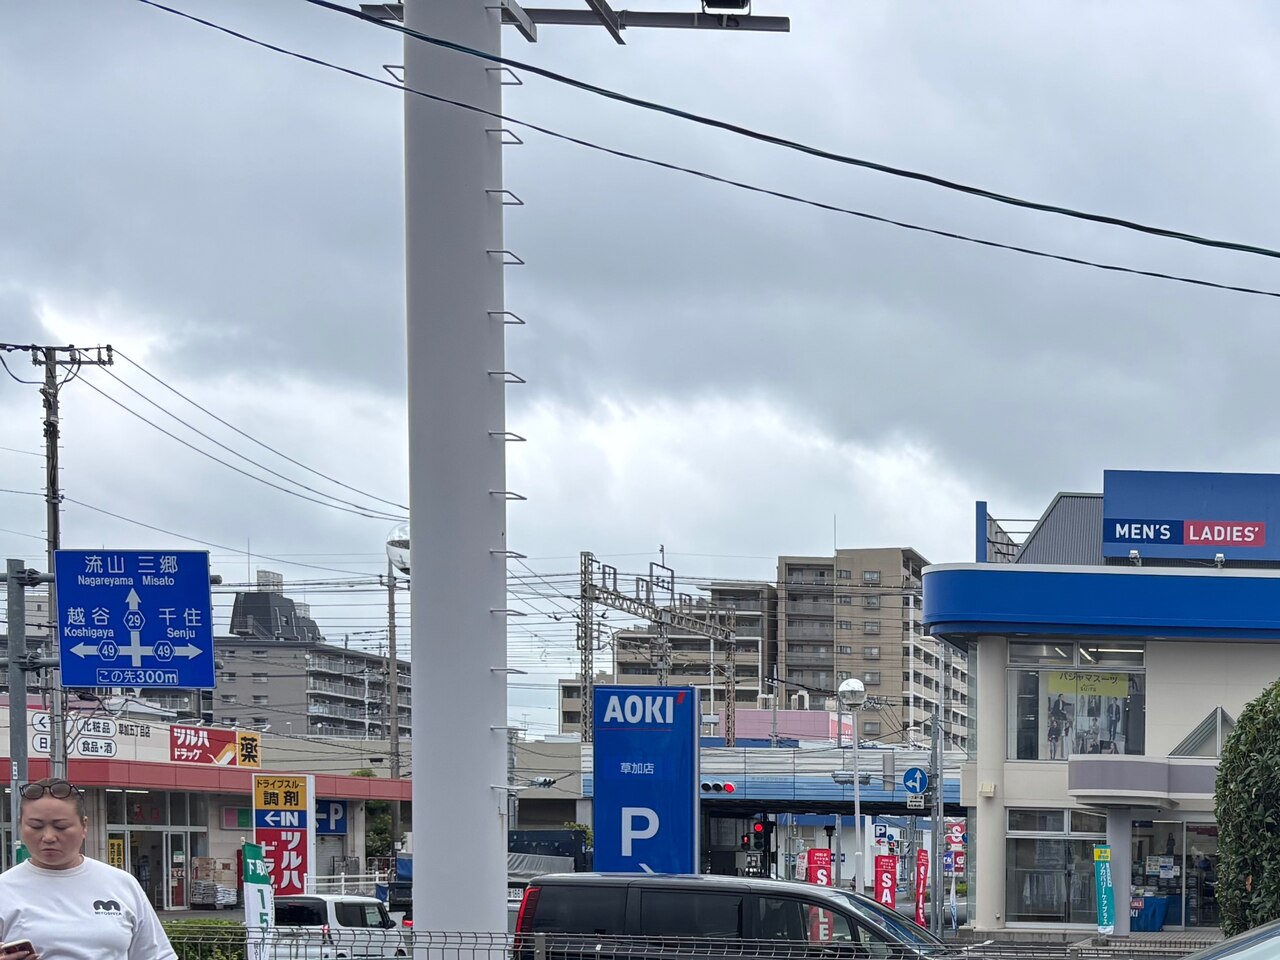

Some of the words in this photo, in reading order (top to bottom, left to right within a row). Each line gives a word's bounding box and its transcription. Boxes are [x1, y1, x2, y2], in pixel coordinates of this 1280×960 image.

[1115, 523, 1171, 540] MEN'S
[1189, 525, 1259, 543] LADIES'
[85, 555, 125, 574] 流山
[138, 555, 179, 574] 三郷
[78, 575, 134, 587] Nagareyama
[142, 575, 175, 586] Misato
[67, 607, 110, 626] 越谷
[128, 615, 141, 627] 29
[158, 607, 202, 627] 千住
[64, 627, 114, 639] Koshigaya
[167, 628, 196, 640] Senju
[101, 645, 115, 657] 49
[157, 645, 170, 657] 49
[99, 670, 178, 683] この先300m
[603, 694, 675, 724] AOKI
[82, 720, 111, 734] 化粧品
[173, 728, 210, 748] ツルハ
[174, 748, 202, 761] ドラッグ
[240, 736, 258, 763] 薬
[620, 762, 654, 775] 草加店
[257, 779, 305, 789] ドライブスルー
[263, 790, 299, 806] 調剤
[280, 811, 299, 827] IN
[329, 803, 344, 830] P
[621, 807, 660, 857] P
[281, 831, 302, 889] ツルハ
